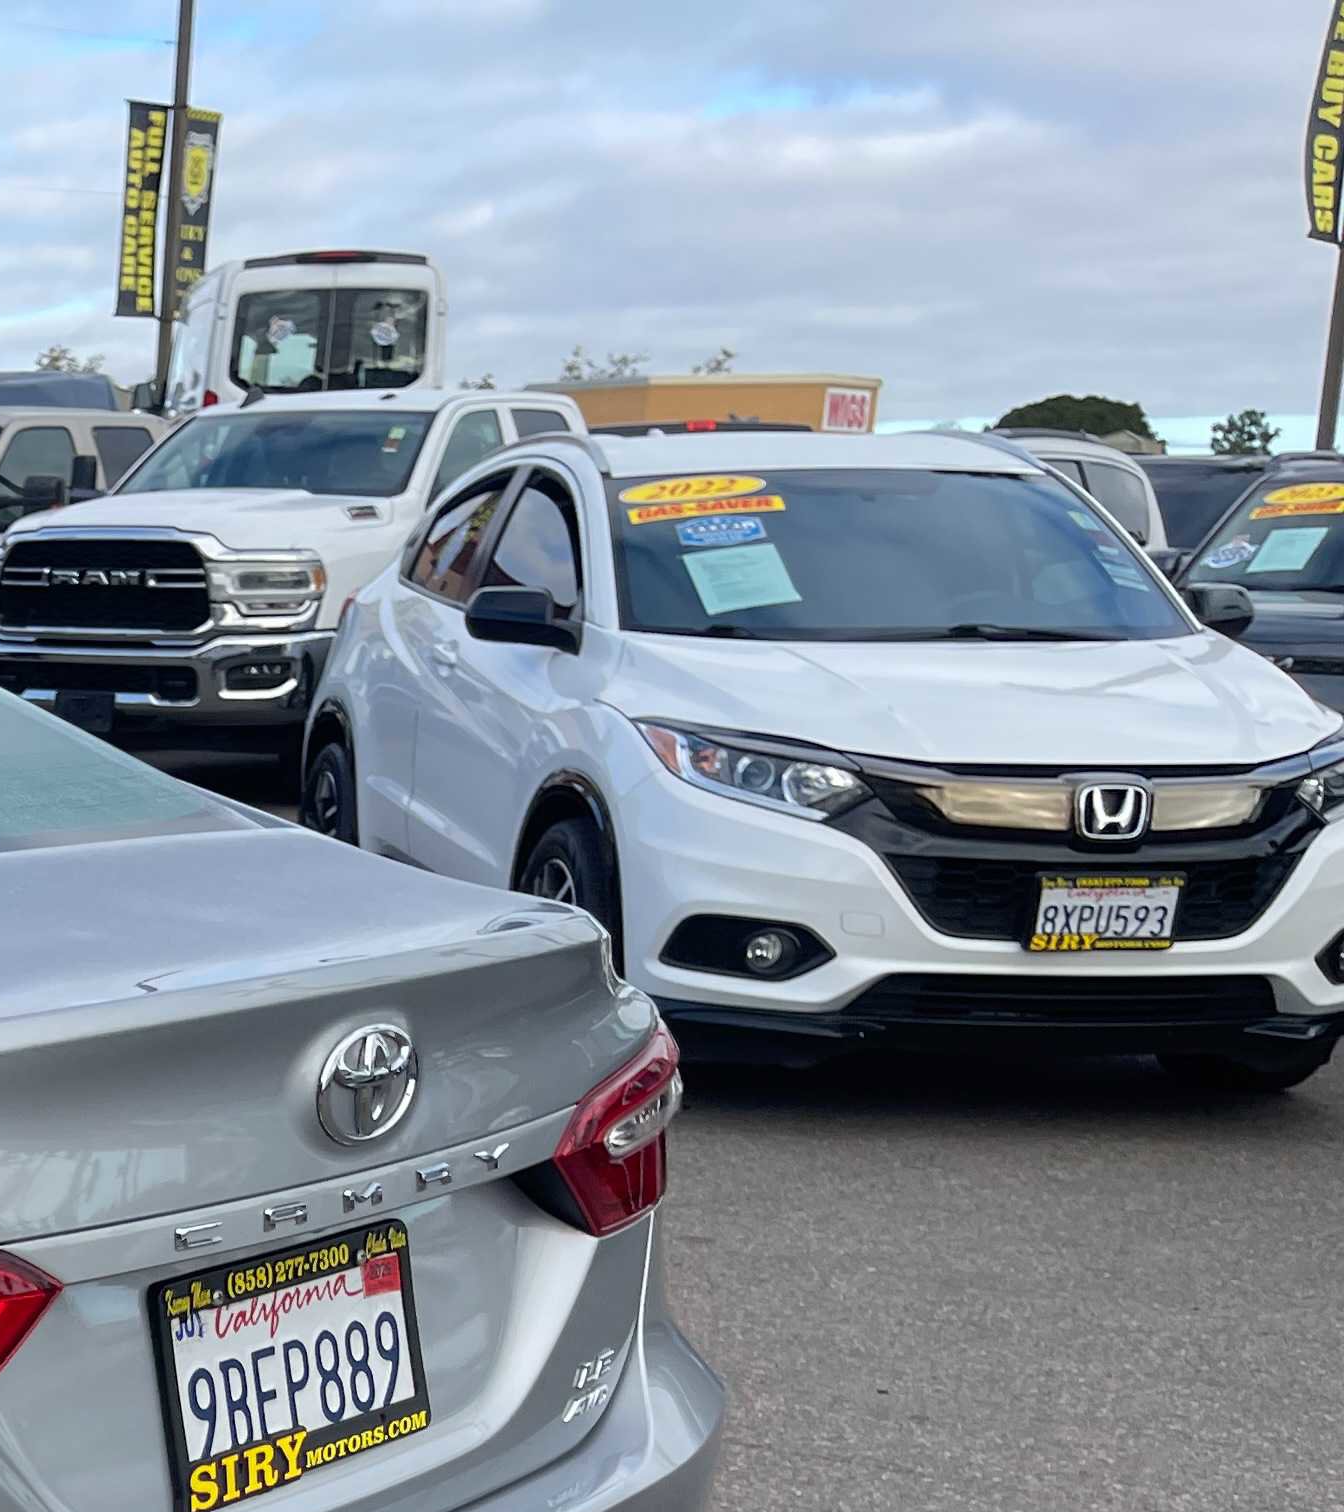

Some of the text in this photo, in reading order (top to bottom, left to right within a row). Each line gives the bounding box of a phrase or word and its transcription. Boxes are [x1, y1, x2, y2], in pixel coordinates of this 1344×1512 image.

[1313, 134, 1339, 233] CARS
[120, 214, 139, 292] CARE
[827, 393, 866, 429] WIGS
[645, 478, 737, 501] 2022
[50, 570, 141, 586] RAM
[1029, 933, 1100, 950] SIRY
[1041, 904, 1169, 938] 8XPU593
[174, 1142, 511, 1251] CAMRY
[227, 1263, 273, 1299] (858)
[275, 1243, 350, 1284] 277-7300
[214, 1273, 363, 1339] California
[189, 1410, 428, 1512] SIRY MOTORS.COM
